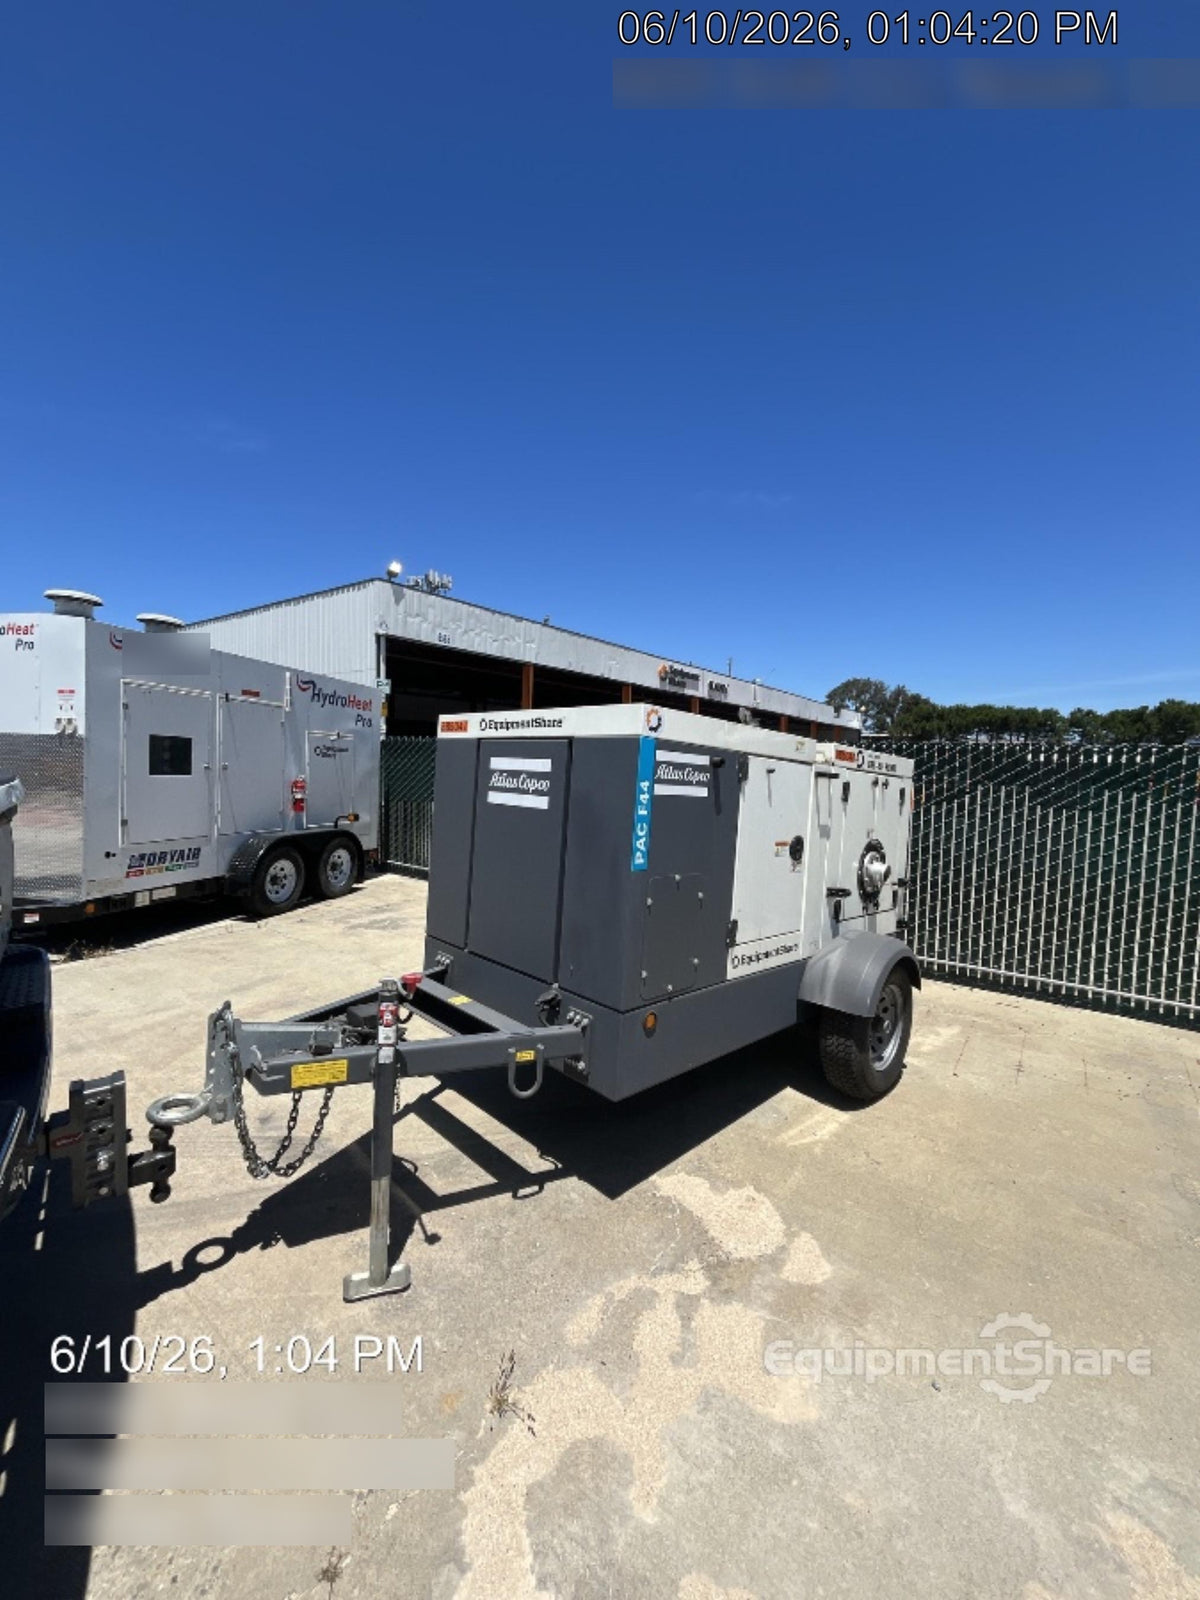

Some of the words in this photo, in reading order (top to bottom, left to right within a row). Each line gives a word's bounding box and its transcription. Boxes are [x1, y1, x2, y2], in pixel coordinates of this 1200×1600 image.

[15, 638, 35, 651] Pro
[310, 687, 372, 712] HydroHeat
[354, 713, 372, 728] Pro
[488, 716, 563, 732] EquipmentShare
[488, 771, 518, 789] Atlas
[518, 772, 551, 794] Copco
[654, 763, 683, 781] Atlas
[684, 767, 711, 785] Copco
[638, 780, 650, 816] F44
[634, 822, 648, 865] PAC
